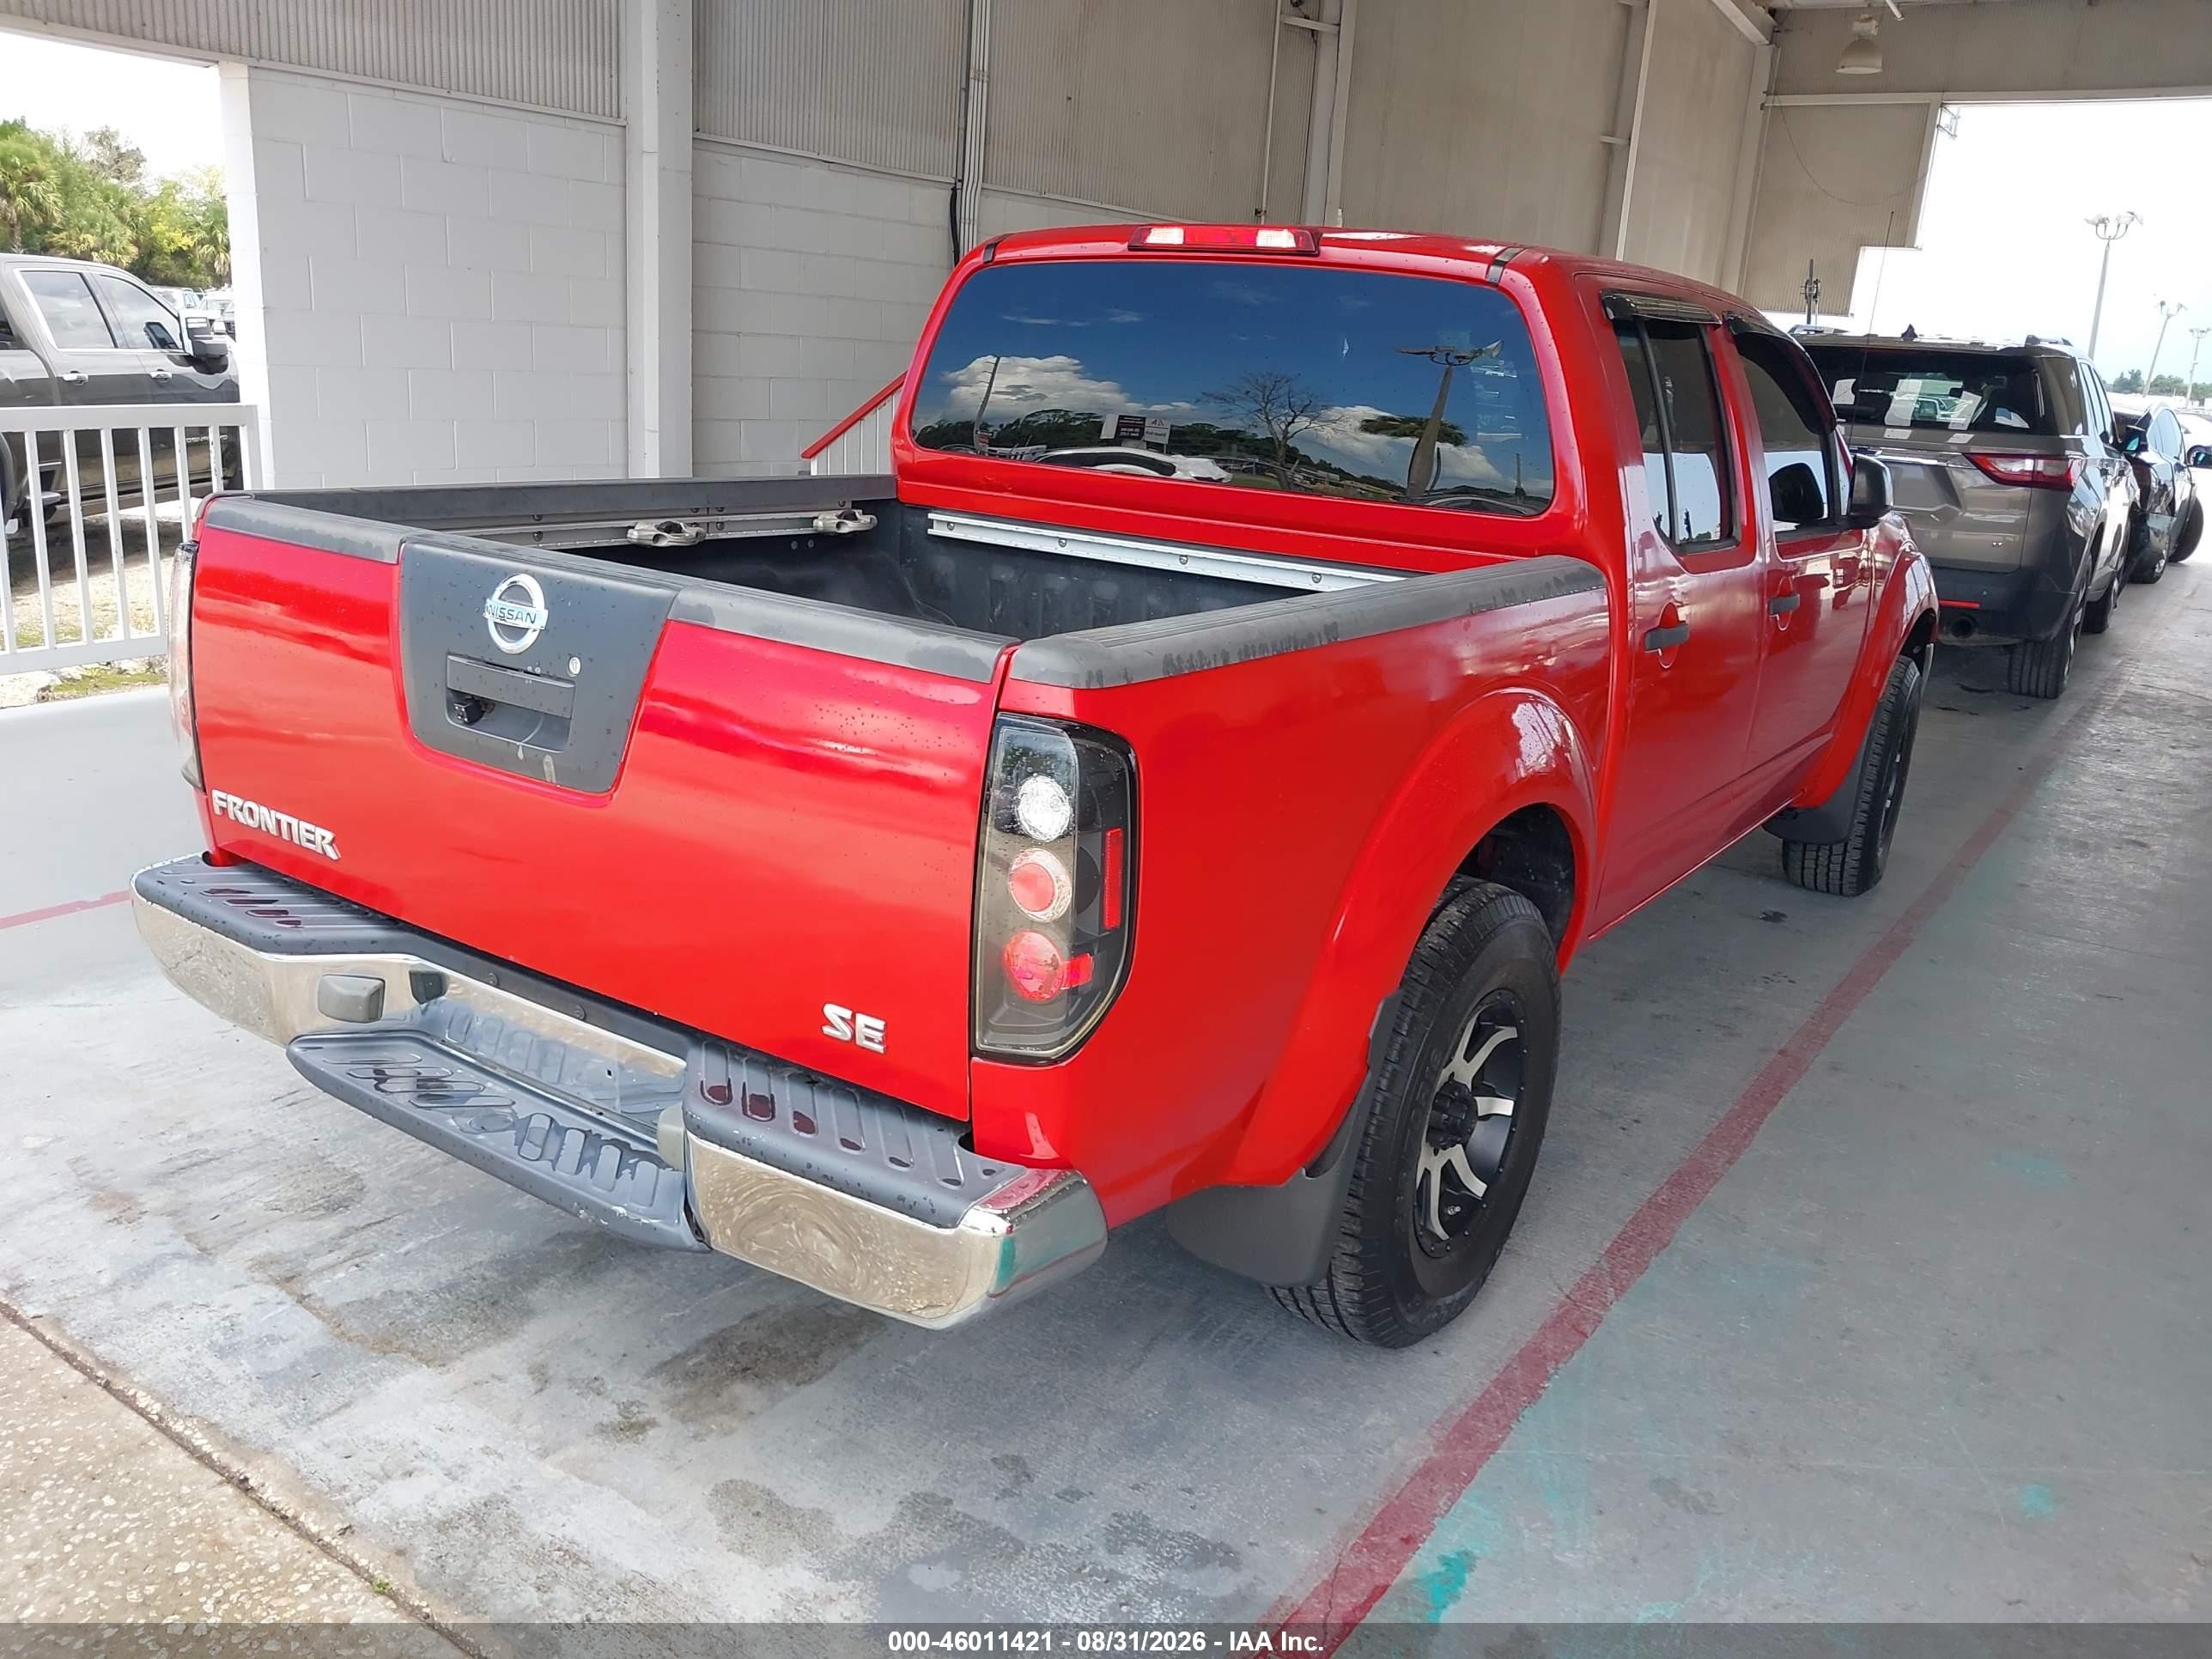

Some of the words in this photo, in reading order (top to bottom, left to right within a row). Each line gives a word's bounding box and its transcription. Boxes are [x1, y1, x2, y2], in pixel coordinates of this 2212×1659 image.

[484, 603, 538, 624] NISSAN
[211, 788, 342, 861] FRONTIER
[821, 1002, 887, 1054] SE
